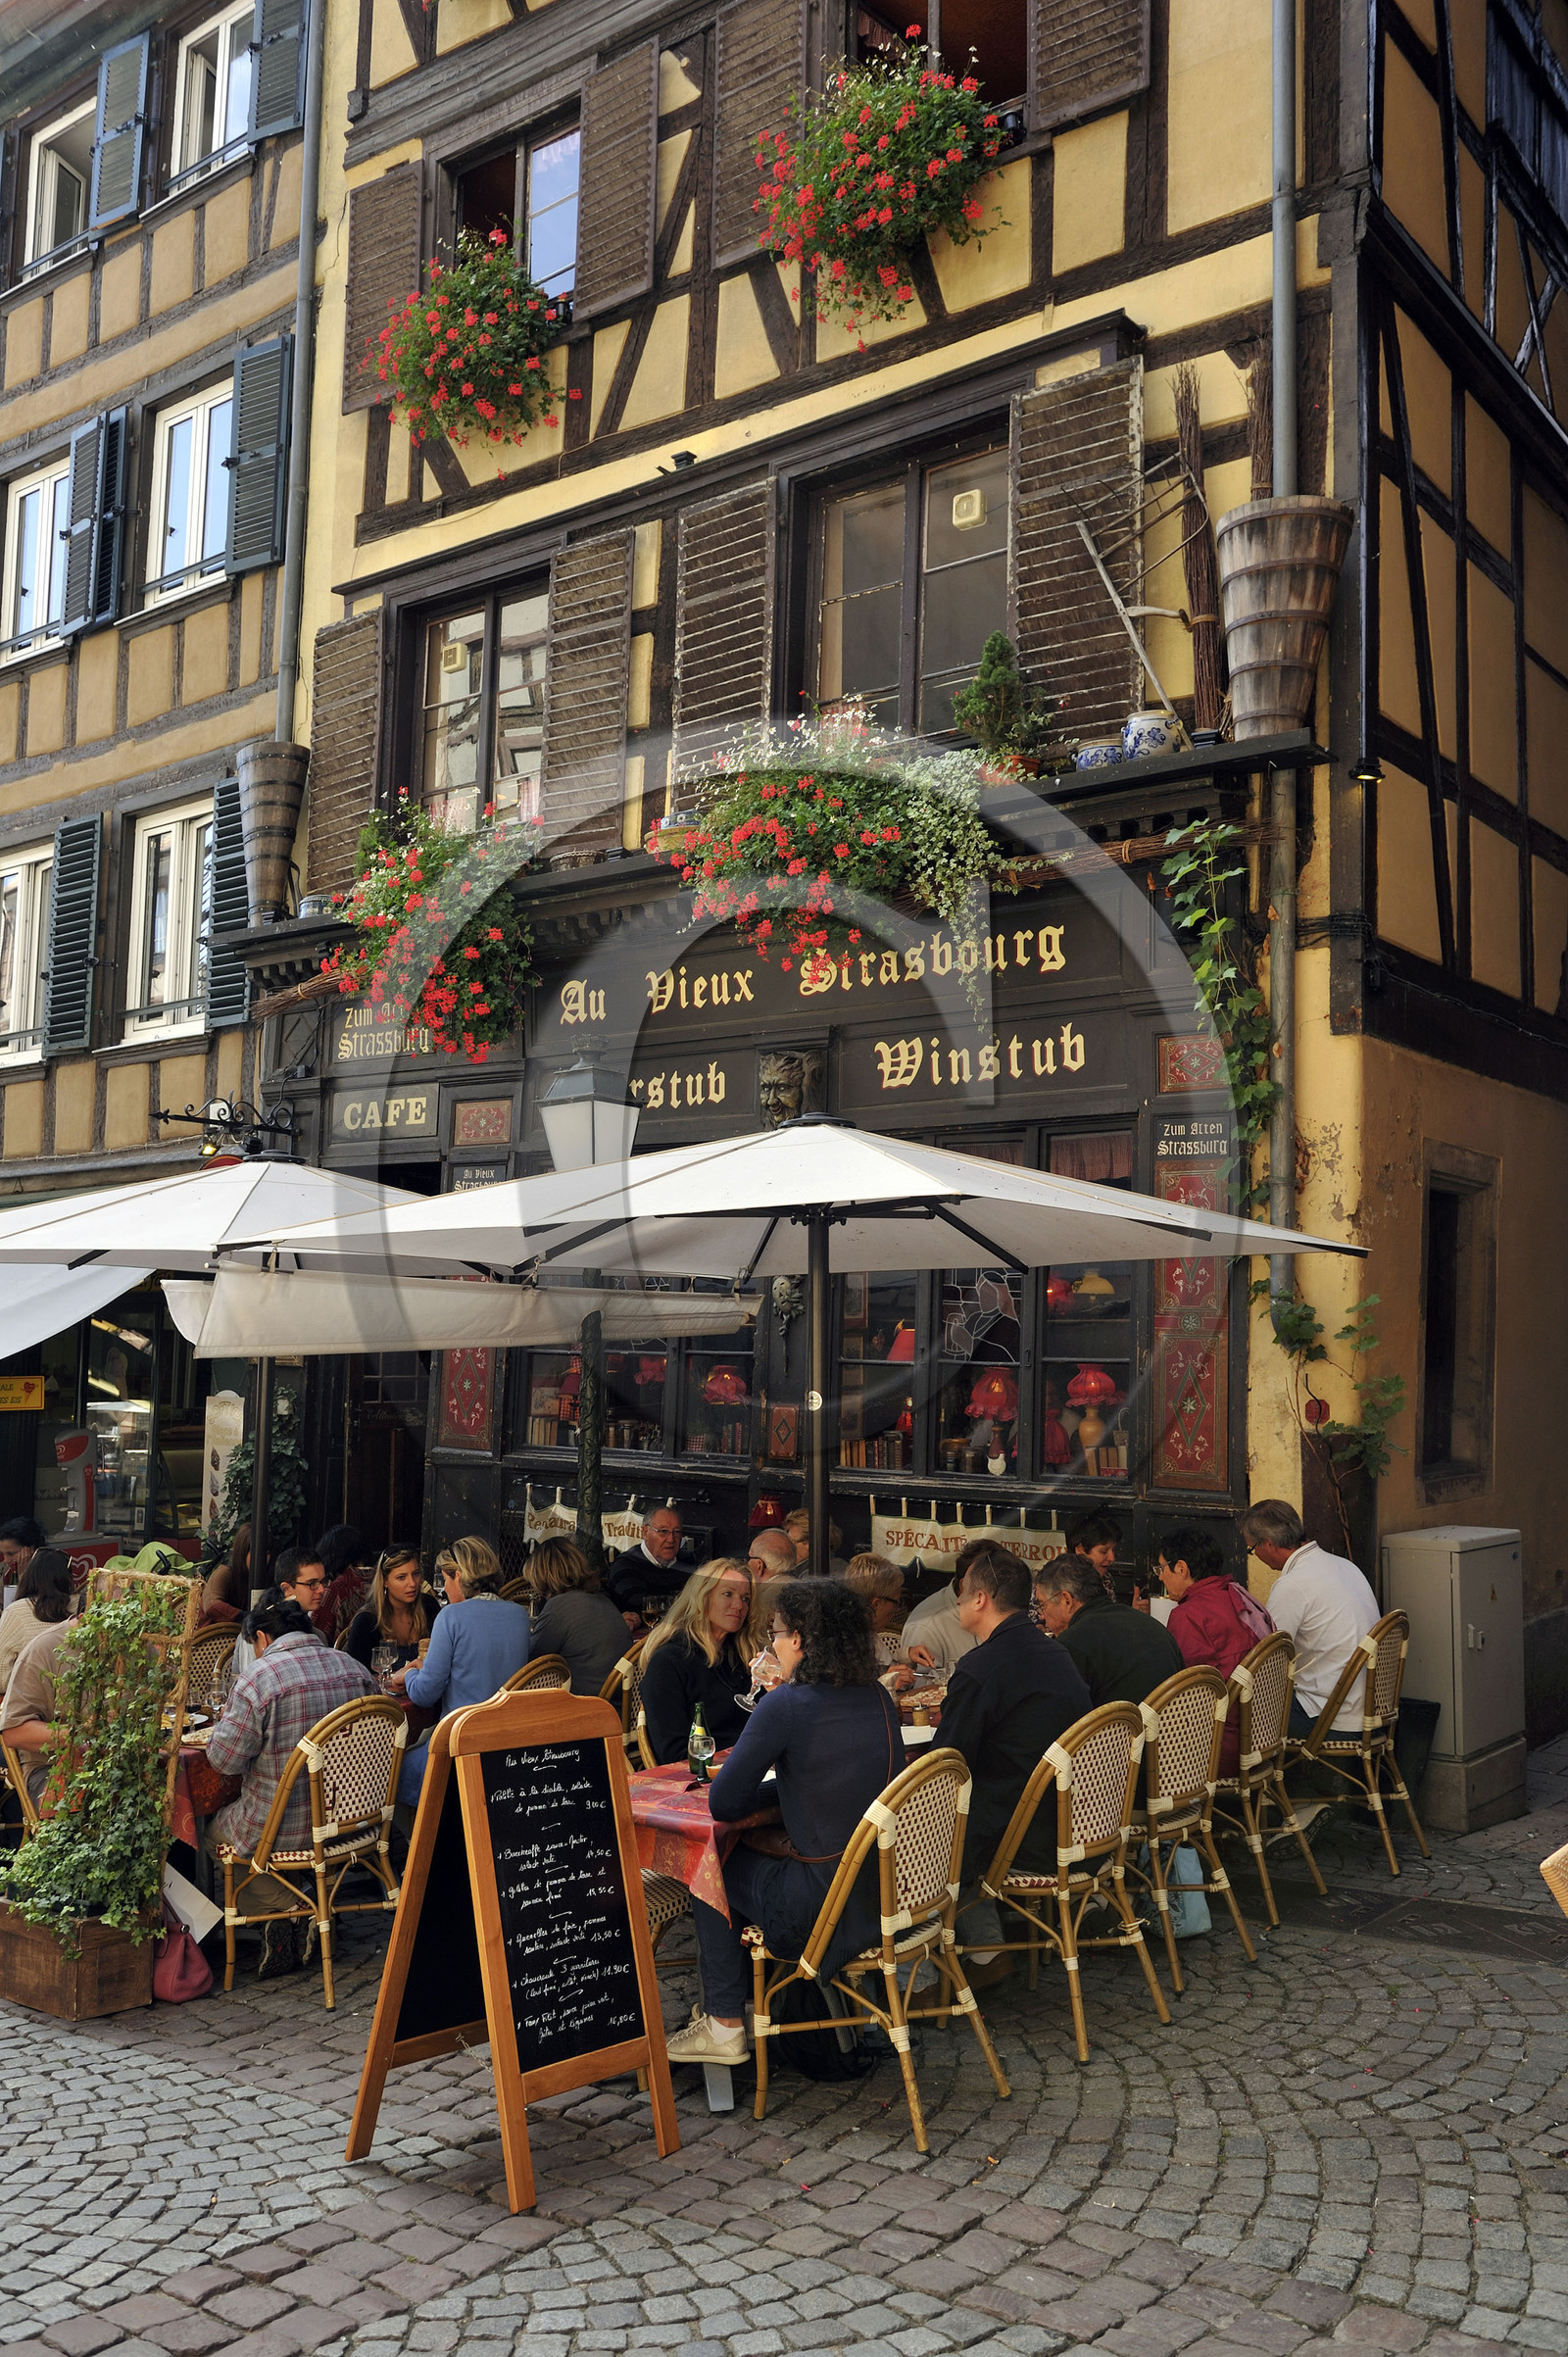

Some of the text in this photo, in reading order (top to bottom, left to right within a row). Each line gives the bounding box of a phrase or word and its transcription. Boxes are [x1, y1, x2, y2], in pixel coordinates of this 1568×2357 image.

[560, 924, 1067, 1025] Au Vieux Strasbourg
[344, 1007, 373, 1029] Zum
[875, 1022, 1087, 1090] Winstub
[344, 1097, 427, 1130] CAFE
[1163, 1124, 1186, 1137] Zum
[1156, 1139, 1228, 1155] Strassburg
[561, 1964, 567, 1974] 3
